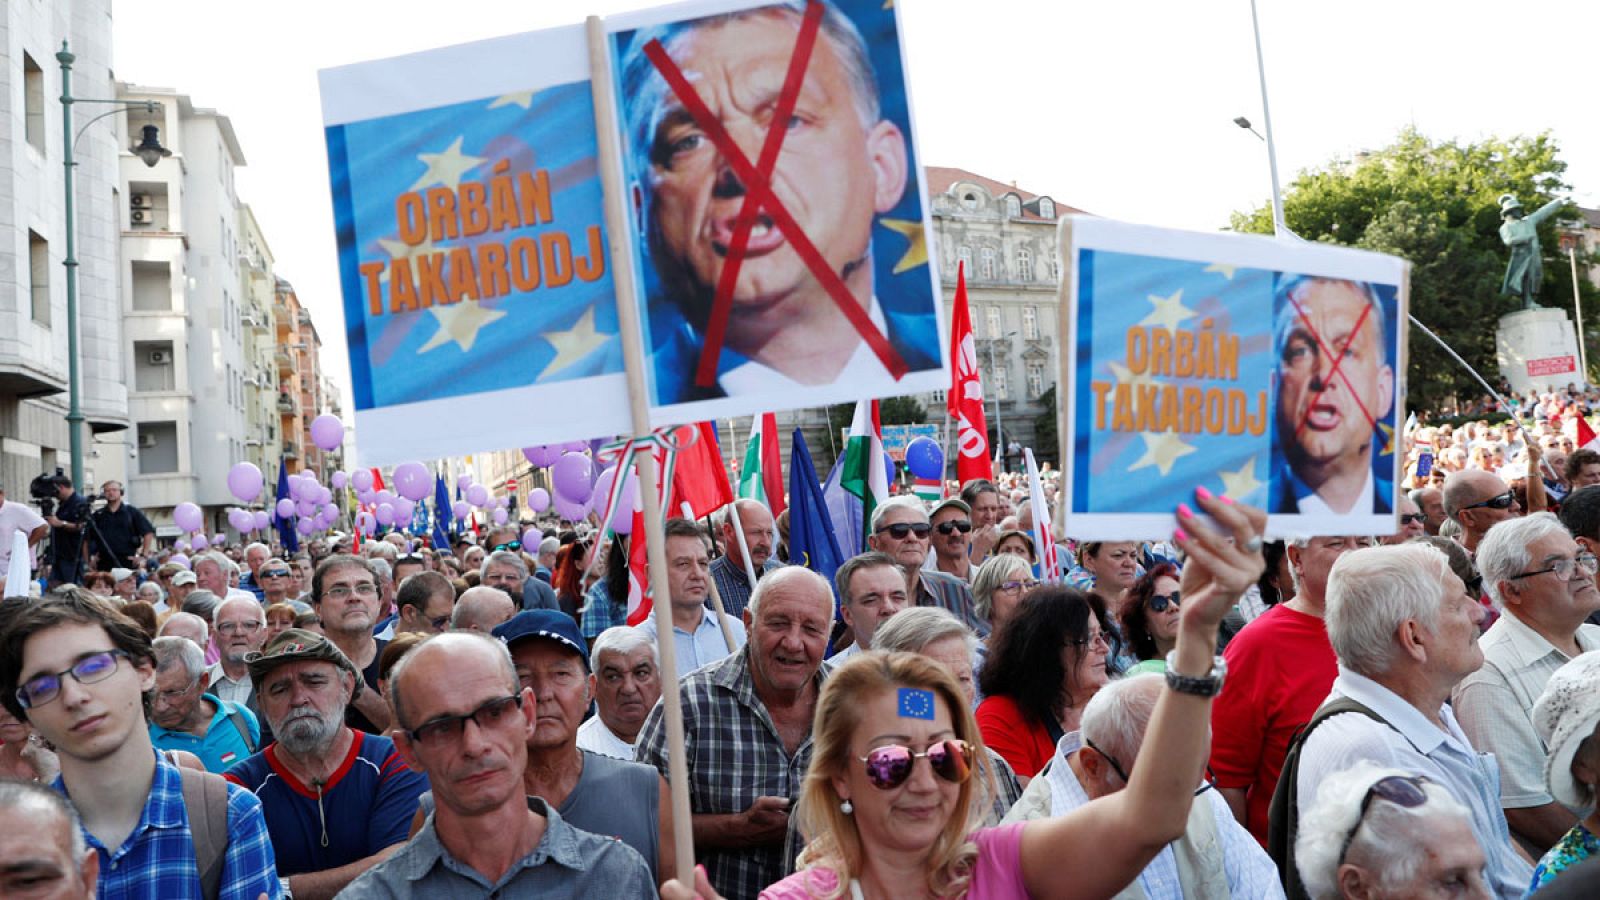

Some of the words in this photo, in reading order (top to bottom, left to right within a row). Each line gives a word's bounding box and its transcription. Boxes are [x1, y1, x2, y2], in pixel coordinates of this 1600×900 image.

[395, 159, 553, 246] ORBÁN
[360, 226, 605, 316] TAKARODJ
[1126, 317, 1240, 380] ORBÁN
[1091, 381, 1267, 437] TAKARODJ
